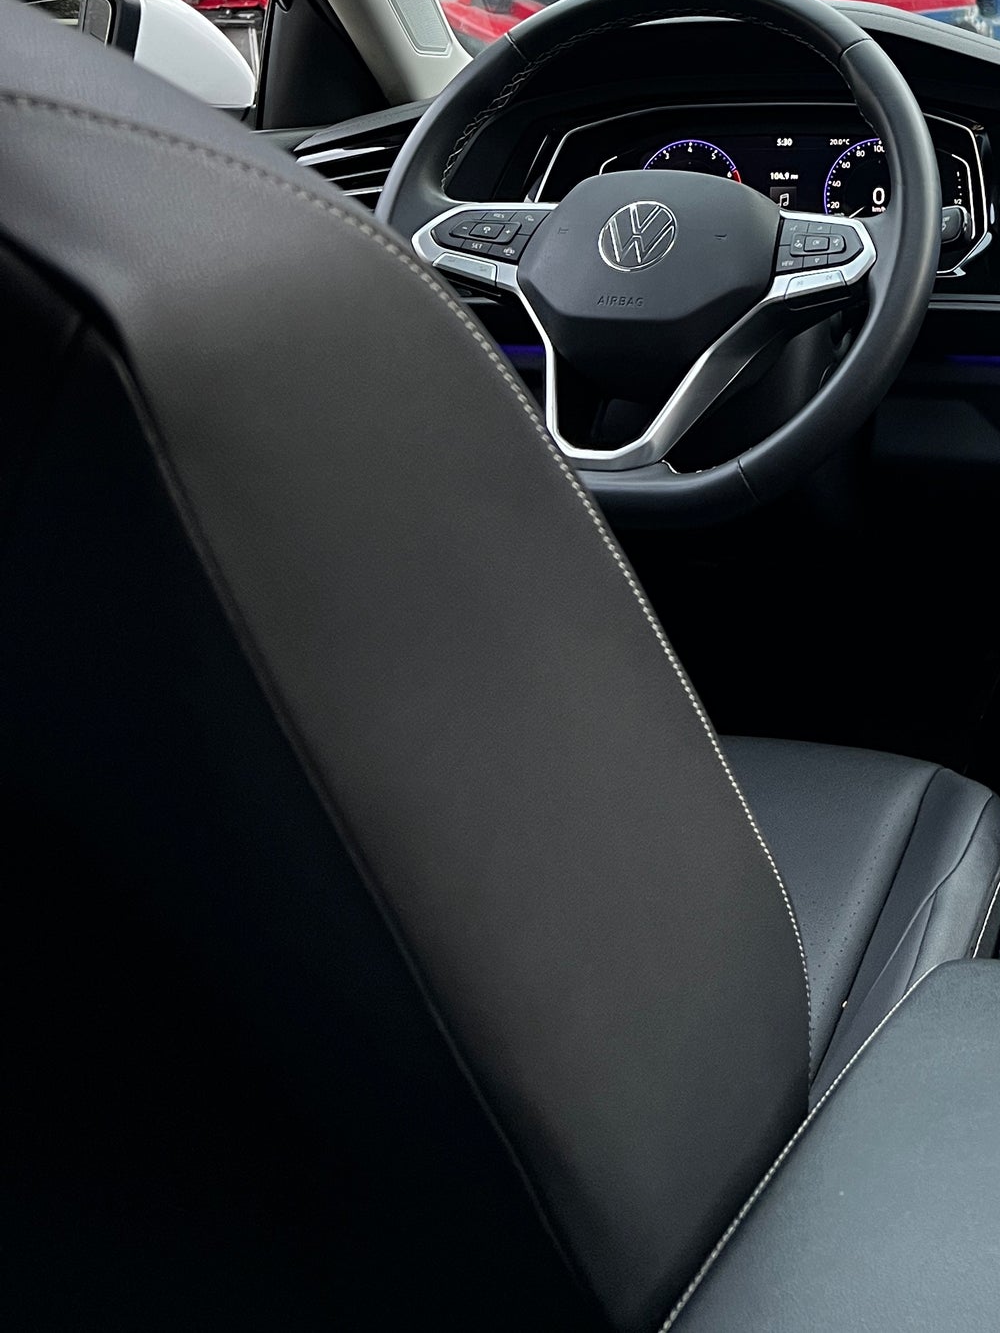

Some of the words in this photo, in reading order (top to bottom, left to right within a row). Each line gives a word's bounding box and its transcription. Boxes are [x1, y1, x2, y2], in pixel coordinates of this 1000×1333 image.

[777, 138, 793, 146] 5:30
[872, 187, 885, 205] 0
[830, 201, 840, 209] 20
[597, 295, 644, 307] AIRBAG
